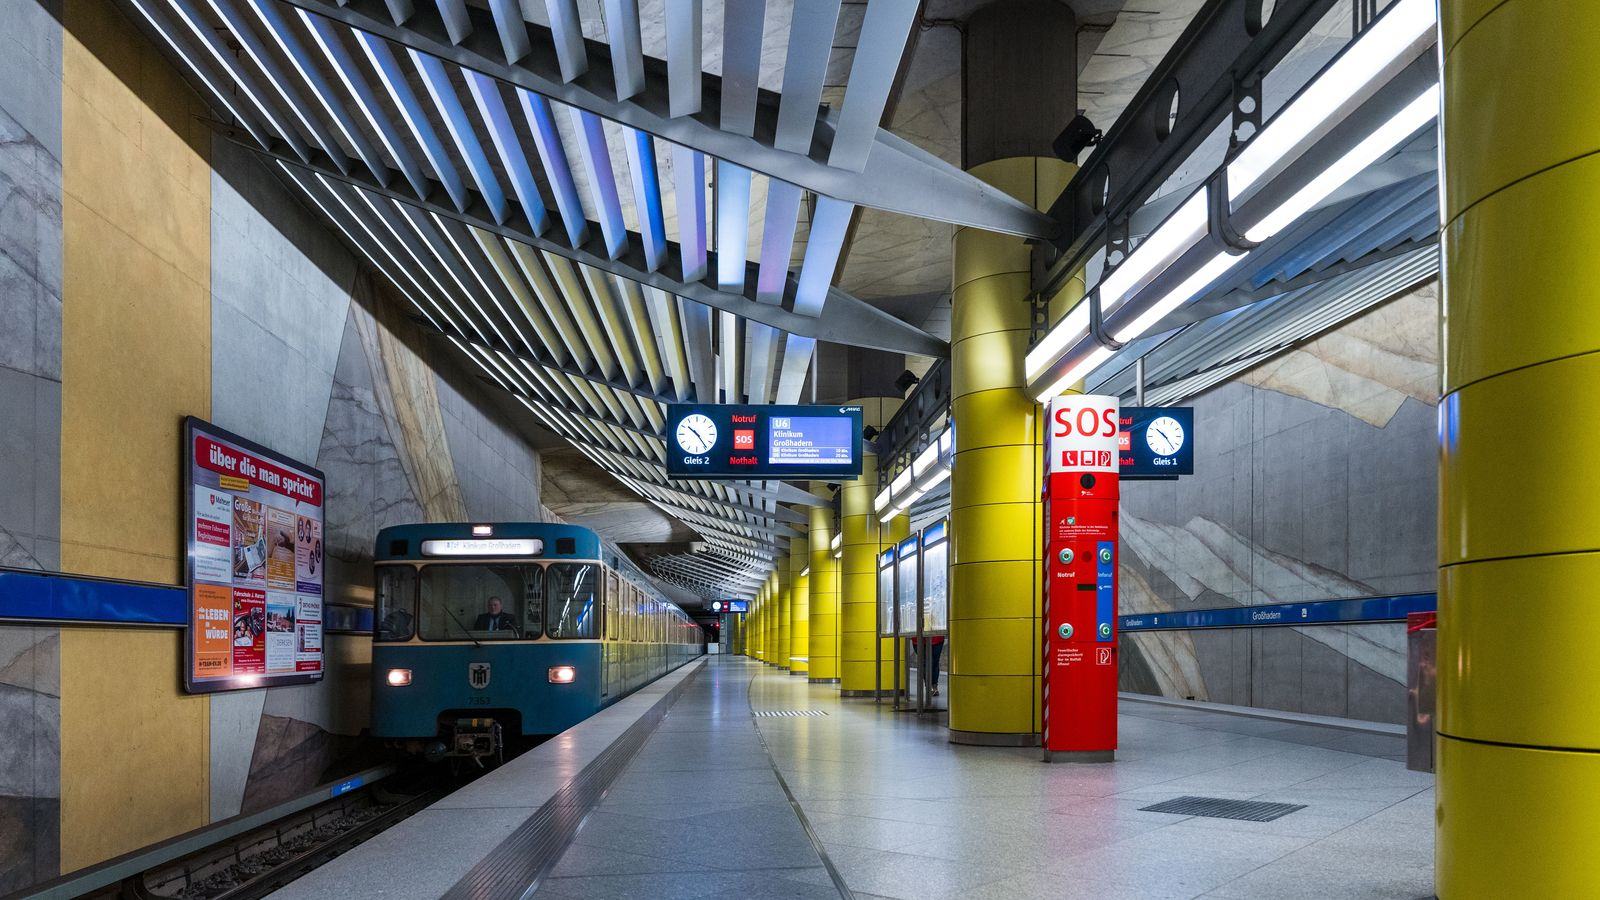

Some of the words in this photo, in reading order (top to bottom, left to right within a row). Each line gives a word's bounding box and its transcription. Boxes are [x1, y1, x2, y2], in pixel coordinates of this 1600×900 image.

[731, 415, 757, 423] Notruf
[774, 419, 788, 428] U6
[1054, 407, 1117, 438] SOS
[1119, 416, 1133, 425] truf
[773, 430, 804, 438] Klinikum
[735, 435, 753, 444] SOS
[773, 439, 813, 447] Großhadern
[1119, 436, 1129, 445] OS
[209, 443, 237, 471] über
[239, 456, 257, 478] die
[259, 466, 281, 487] man
[683, 456, 703, 465] Gleis
[704, 456, 710, 465] 2
[729, 456, 758, 465] Nothalt
[1153, 457, 1171, 466] Gleis
[1172, 458, 1178, 466] 1
[205, 608, 229, 621] LEBEN
[1252, 611, 1281, 621] Großhadern
[205, 626, 228, 640] WÜRDE
